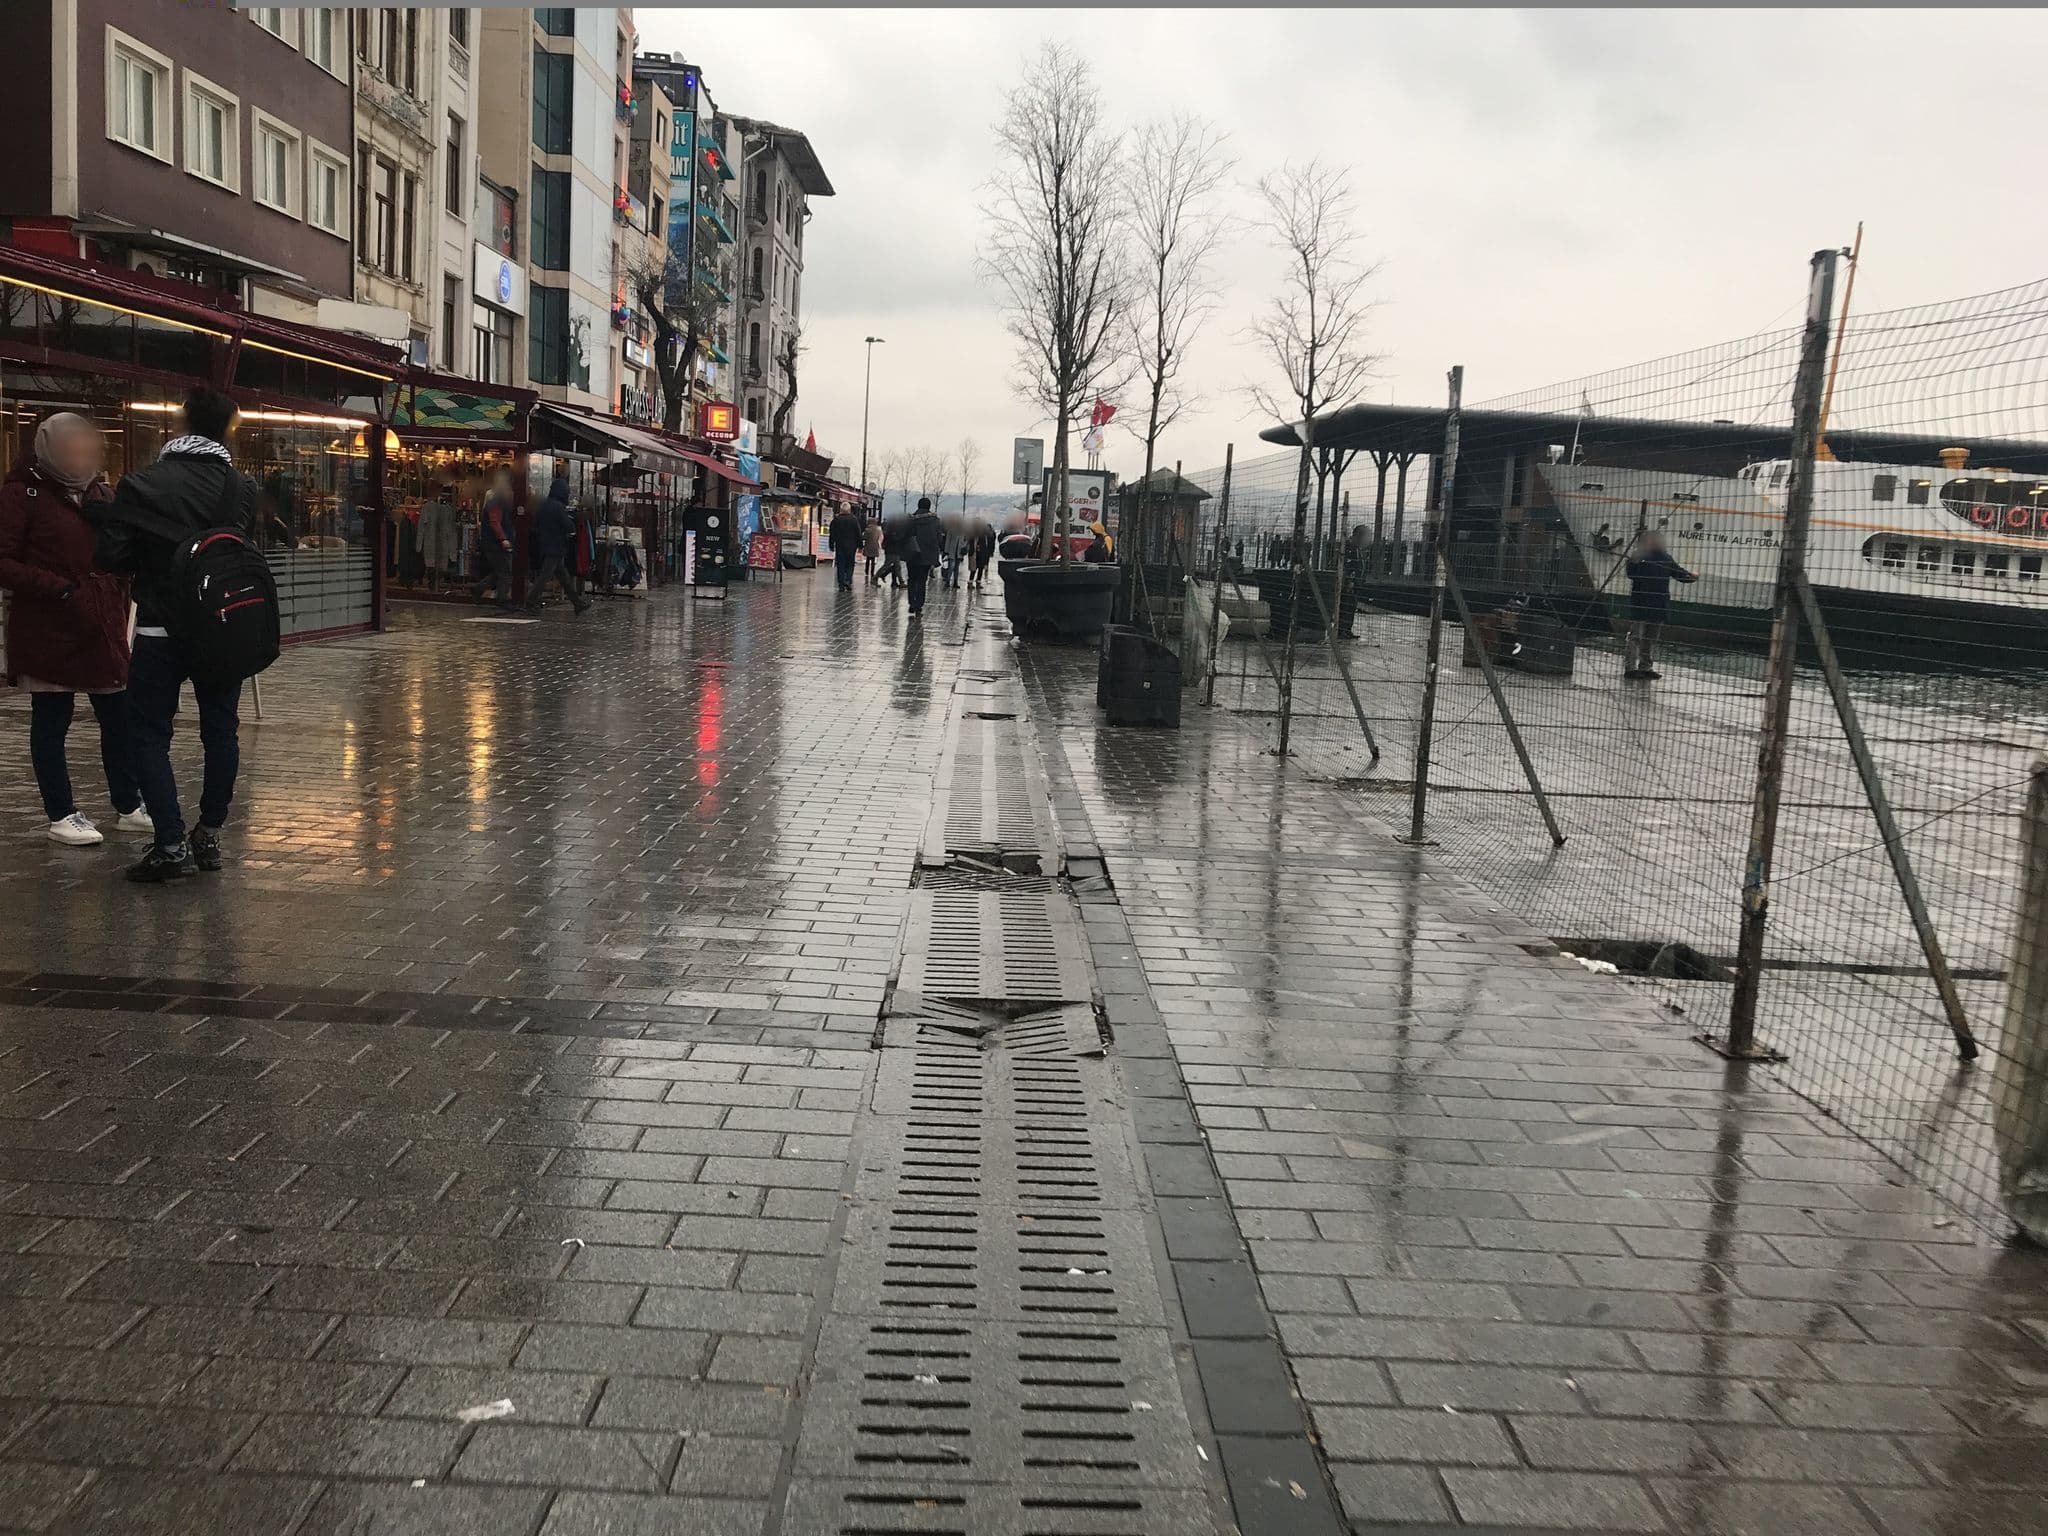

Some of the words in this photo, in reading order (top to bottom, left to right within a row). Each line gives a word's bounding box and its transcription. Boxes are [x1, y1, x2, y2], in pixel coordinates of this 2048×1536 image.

[674, 120, 689, 145] it
[670, 156, 690, 177] ANT
[712, 409, 728, 428] E
[1731, 536, 1783, 548] ALPTOGA
